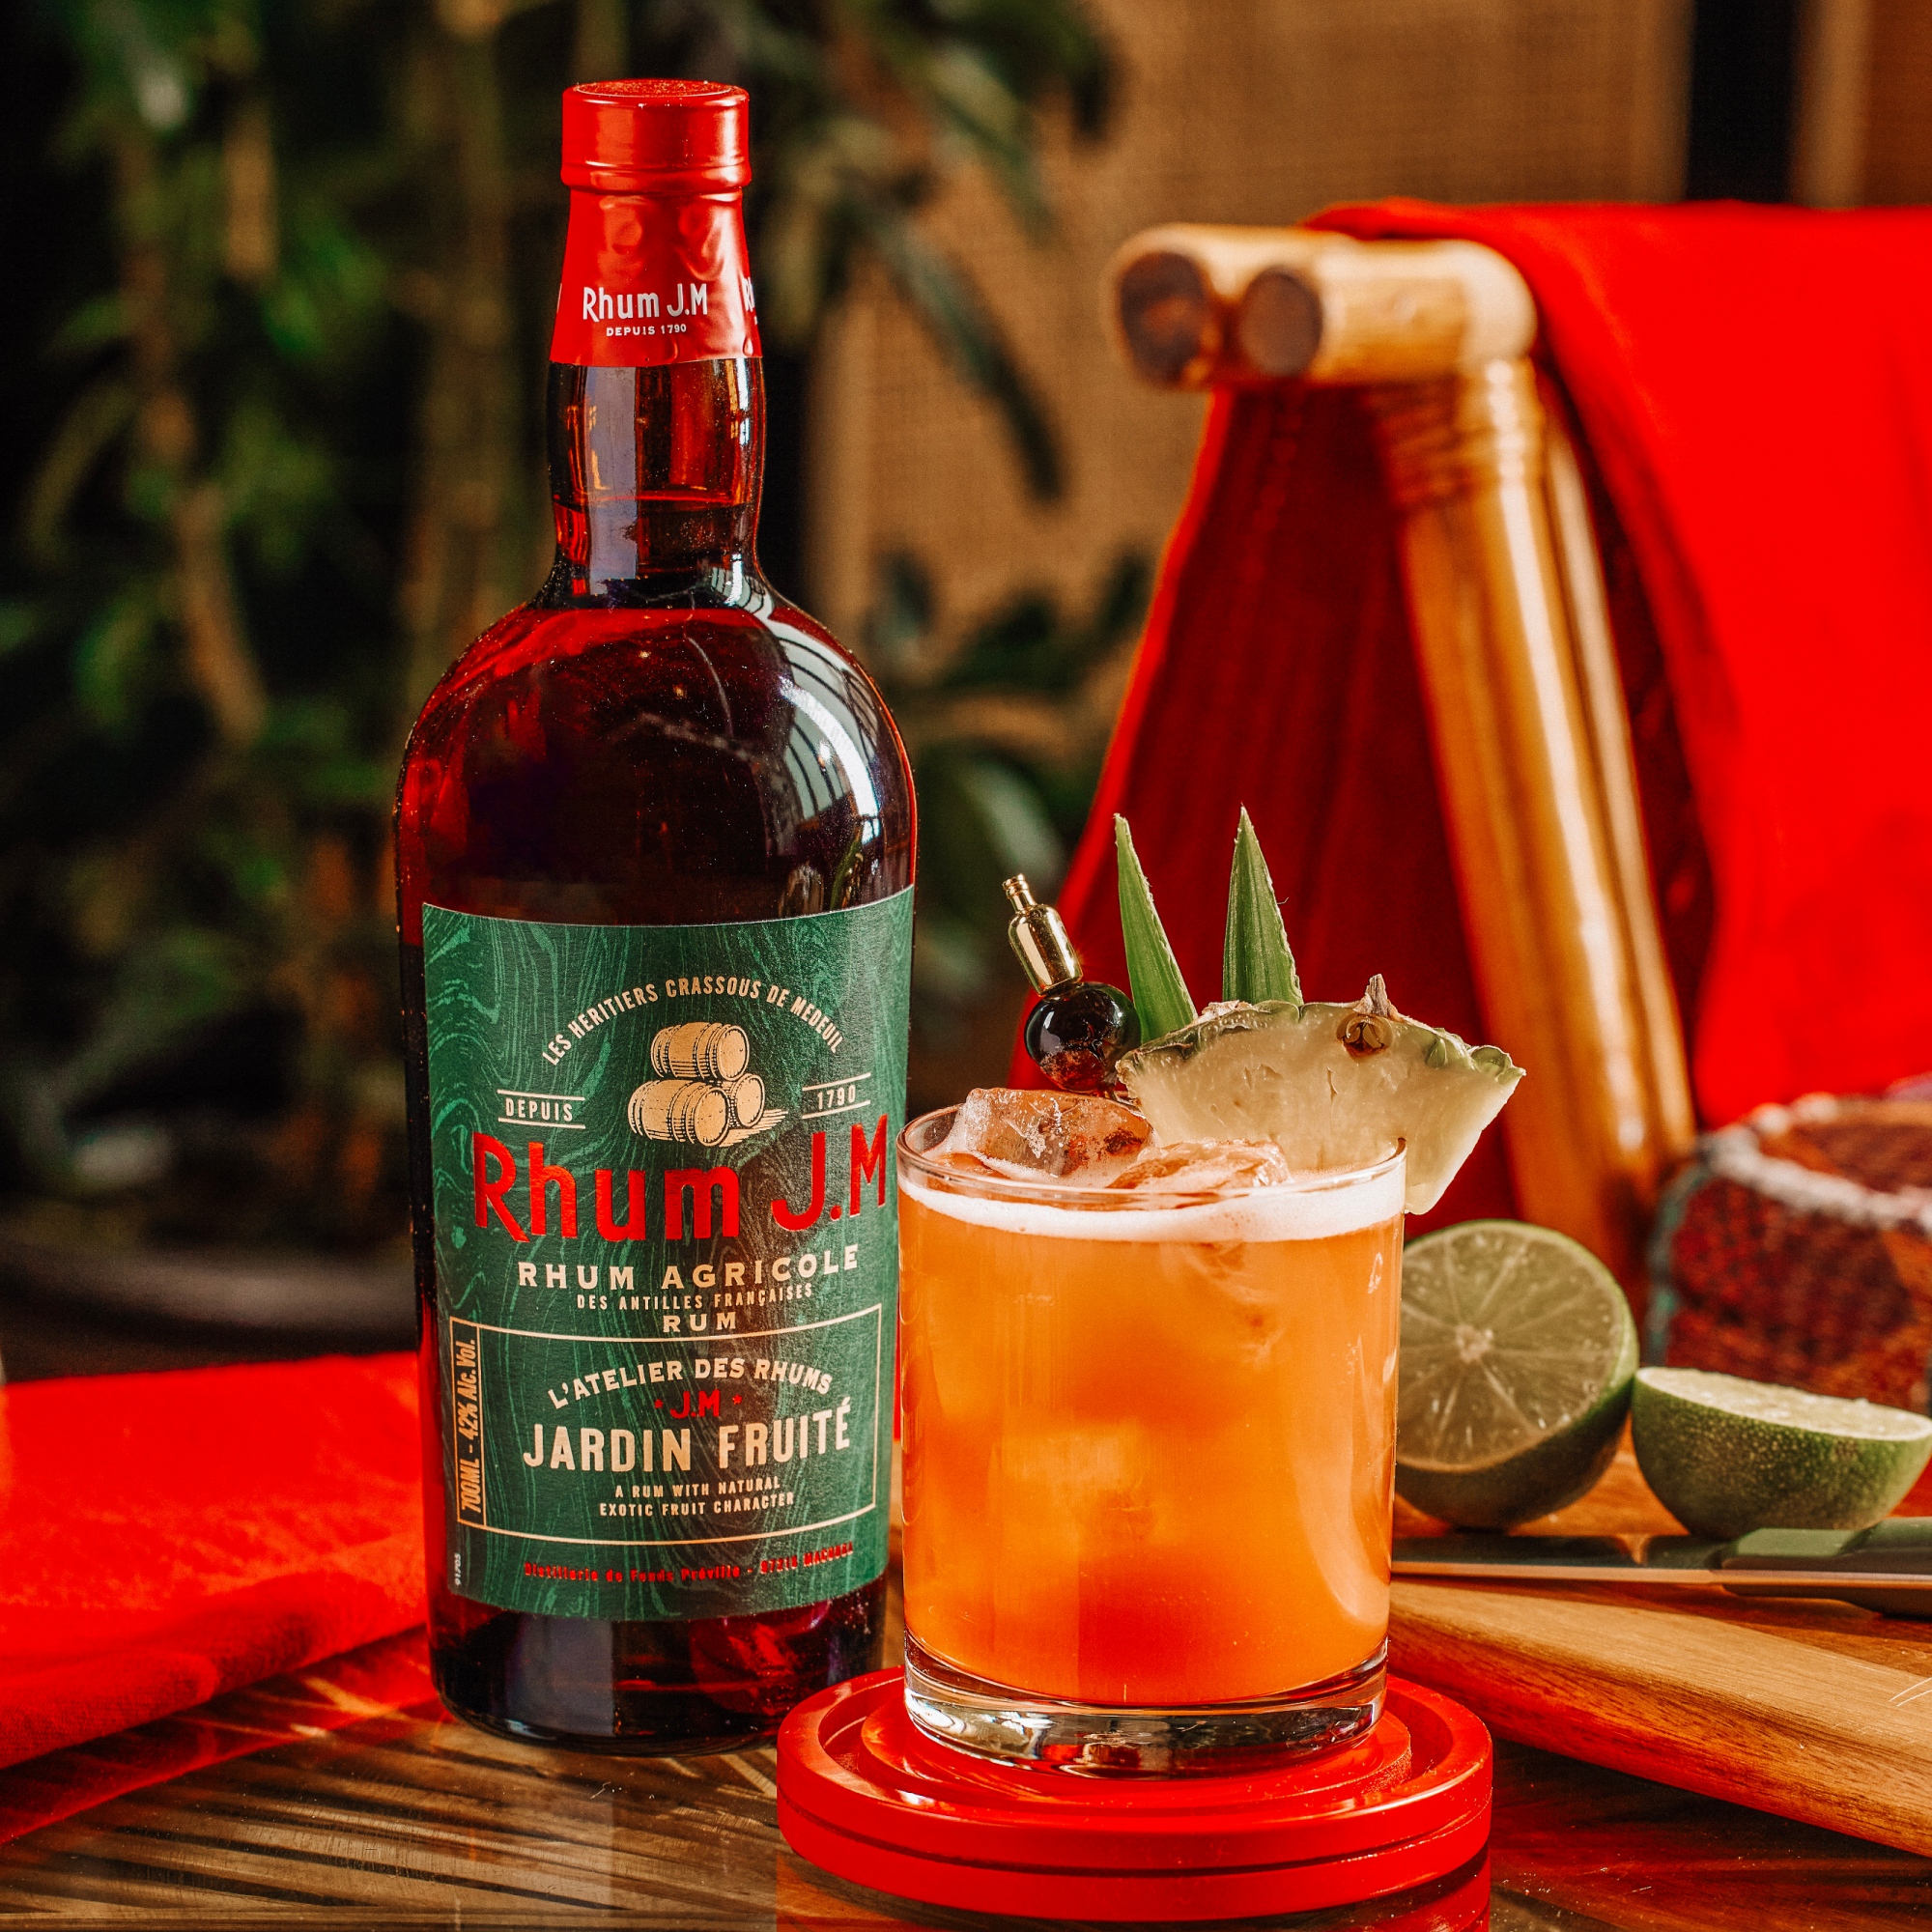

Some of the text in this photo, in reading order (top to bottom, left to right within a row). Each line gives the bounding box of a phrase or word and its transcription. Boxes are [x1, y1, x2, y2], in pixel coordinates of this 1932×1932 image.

[582, 287, 660, 322] Rhum
[667, 283, 708, 316] J.M
[607, 324, 687, 336] DEPUIS 1790
[542, 977, 844, 1065] LES HERITIERS CRASSOUS DE MEDEUIL
[505, 1099, 573, 1122] DEPUIS
[817, 1085, 856, 1110] 1790
[472, 1114, 889, 1242] Rhum J.M
[518, 1244, 859, 1291] RHUM AGRICOLE
[577, 1283, 813, 1311] DES ANTILLES FRANÇAISES
[663, 1312, 737, 1333] RUM
[695, 1357, 746, 1379] DES
[754, 1359, 834, 1396] RHUMS
[669, 1389, 721, 1419] J.M
[458, 1402, 479, 1440] 42%
[523, 1397, 852, 1472] JARDIN FRUITÉ
[614, 1475, 781, 1498] A RUM WITH NATURAL
[599, 1492, 795, 1518] EXOTIC FRUIT CHARACTER
[525, 1562, 599, 1581] Distillerie
[606, 1569, 623, 1582] de
